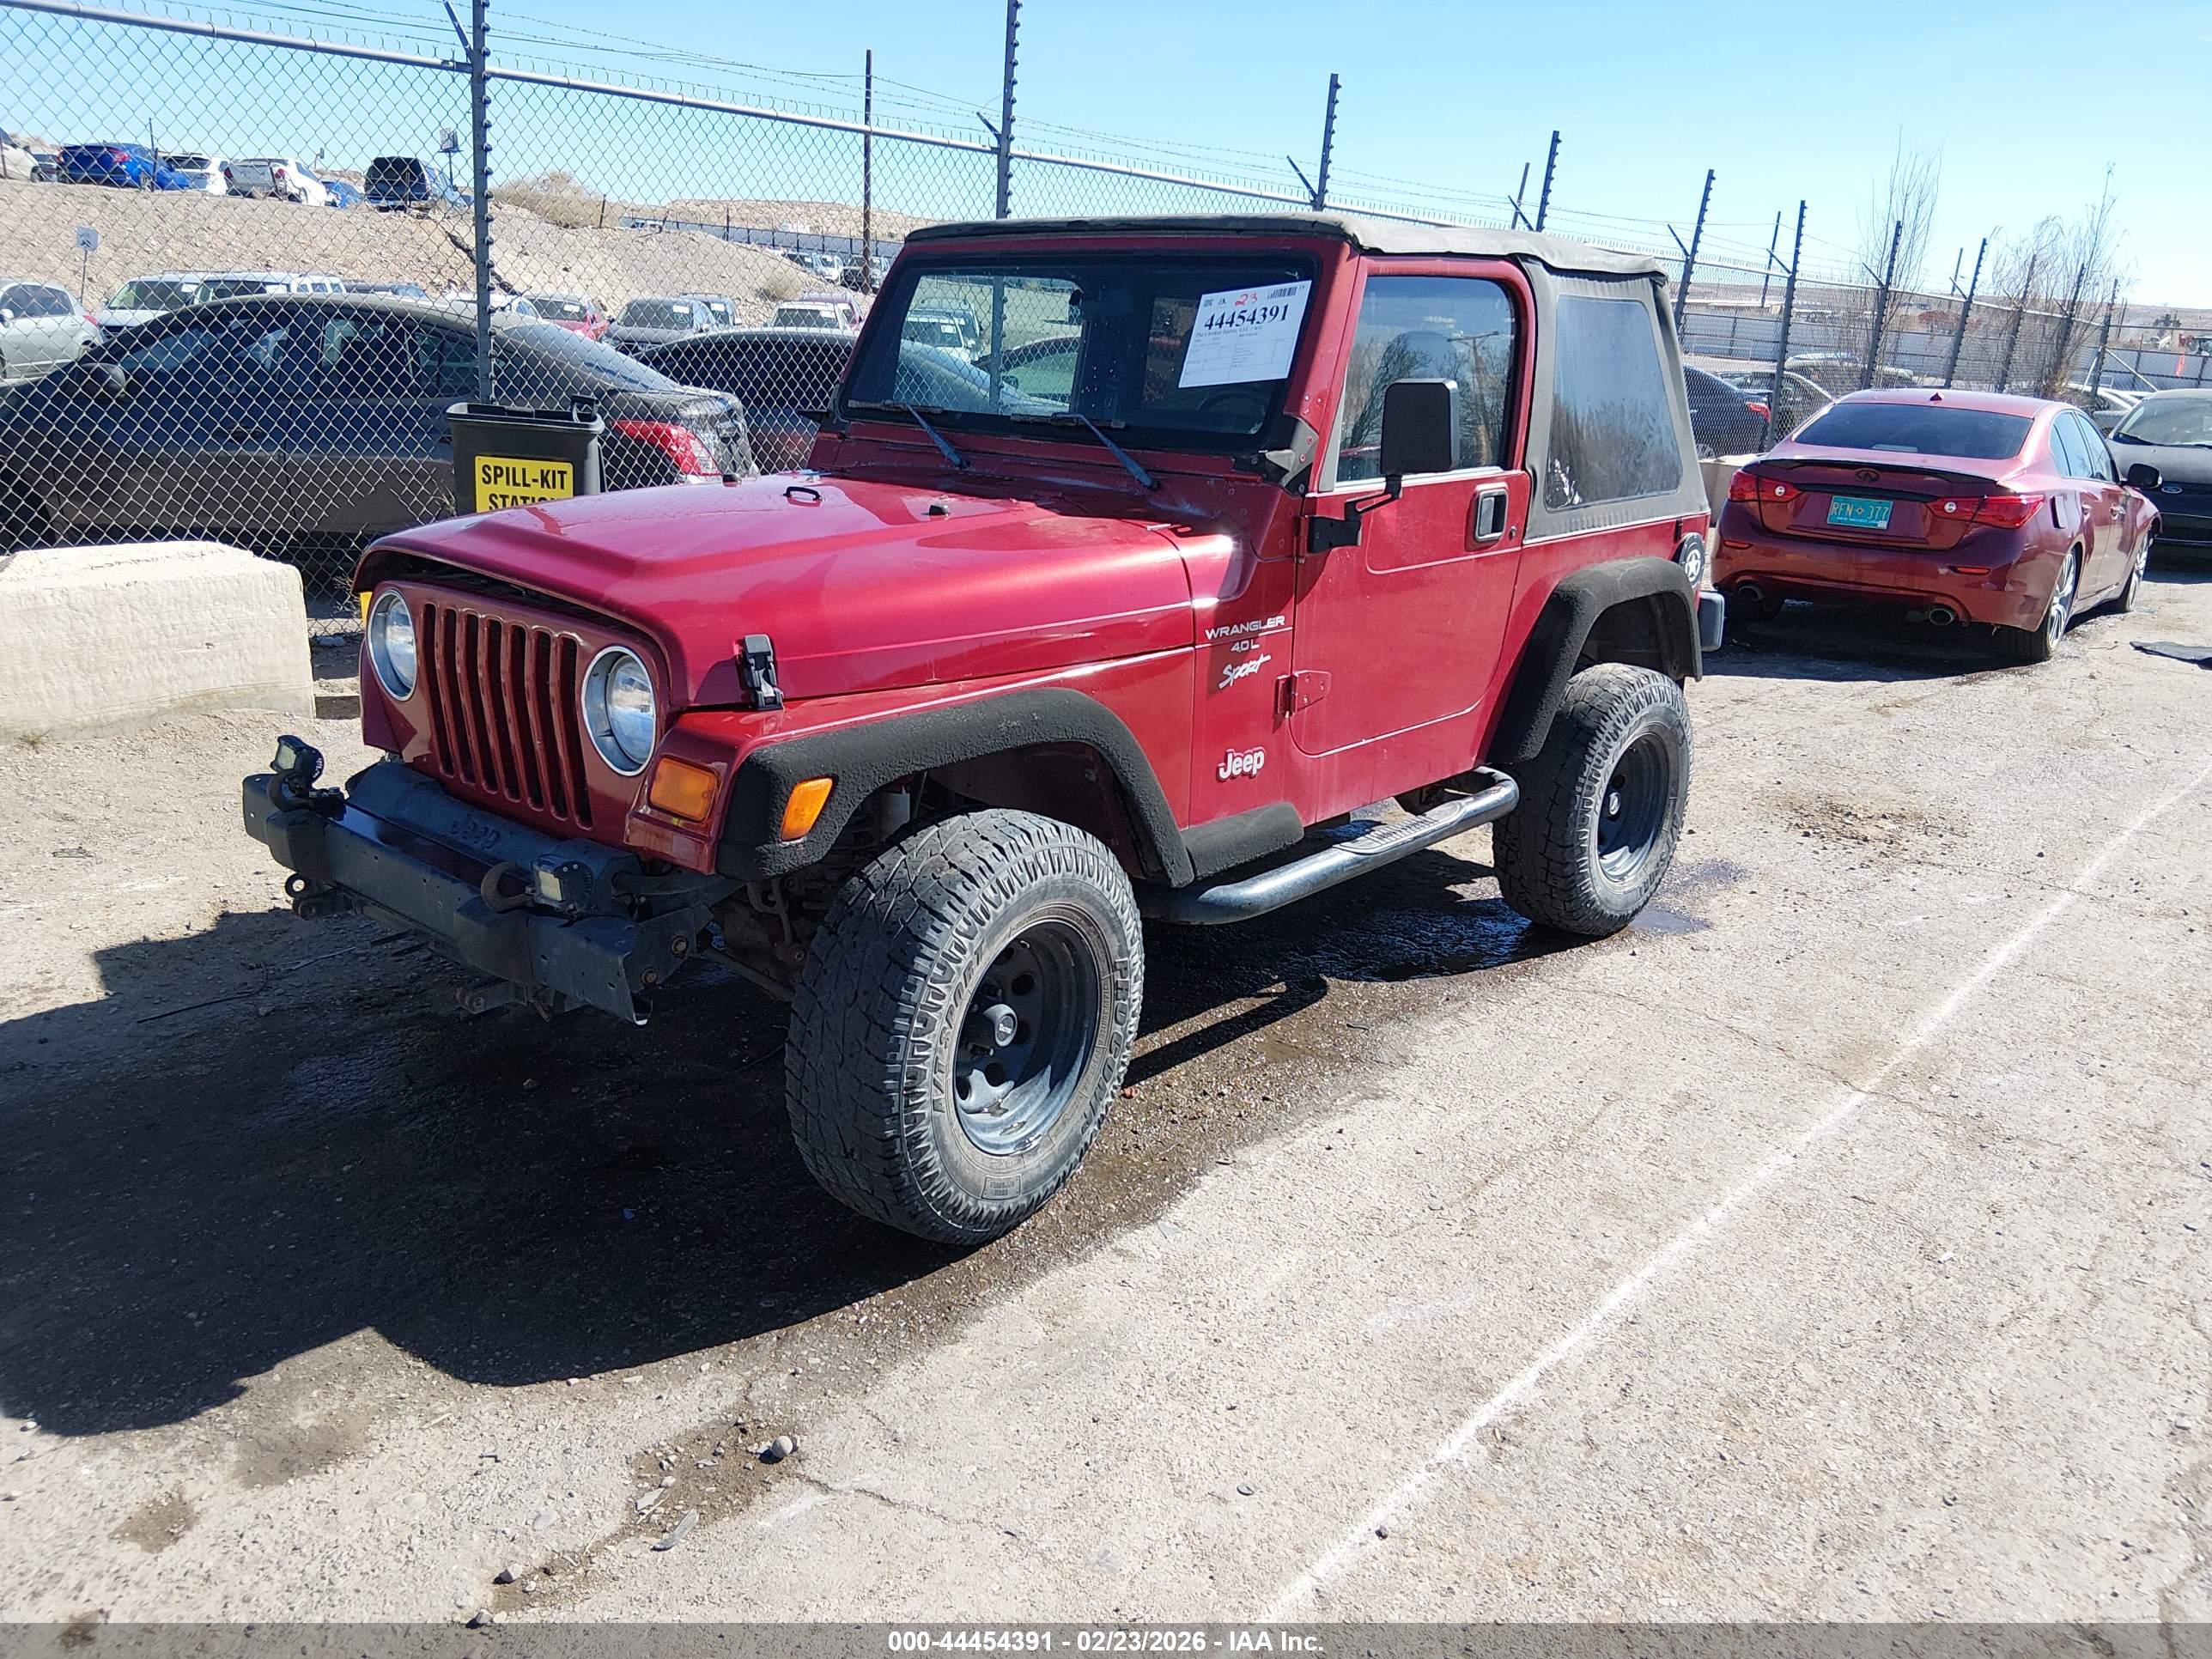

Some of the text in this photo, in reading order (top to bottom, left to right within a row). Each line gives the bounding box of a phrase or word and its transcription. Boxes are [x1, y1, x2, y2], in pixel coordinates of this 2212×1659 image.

[1235, 293, 1258, 306] 23
[1204, 304, 1289, 331] 44454391
[481, 464, 568, 489] SPILL-KIT
[488, 493, 560, 511] STAT
[1831, 502, 1854, 517] RFN
[1205, 616, 1285, 641] WRANGLER
[1218, 653, 1271, 689] Sport
[1218, 748, 1266, 779] Jeep
